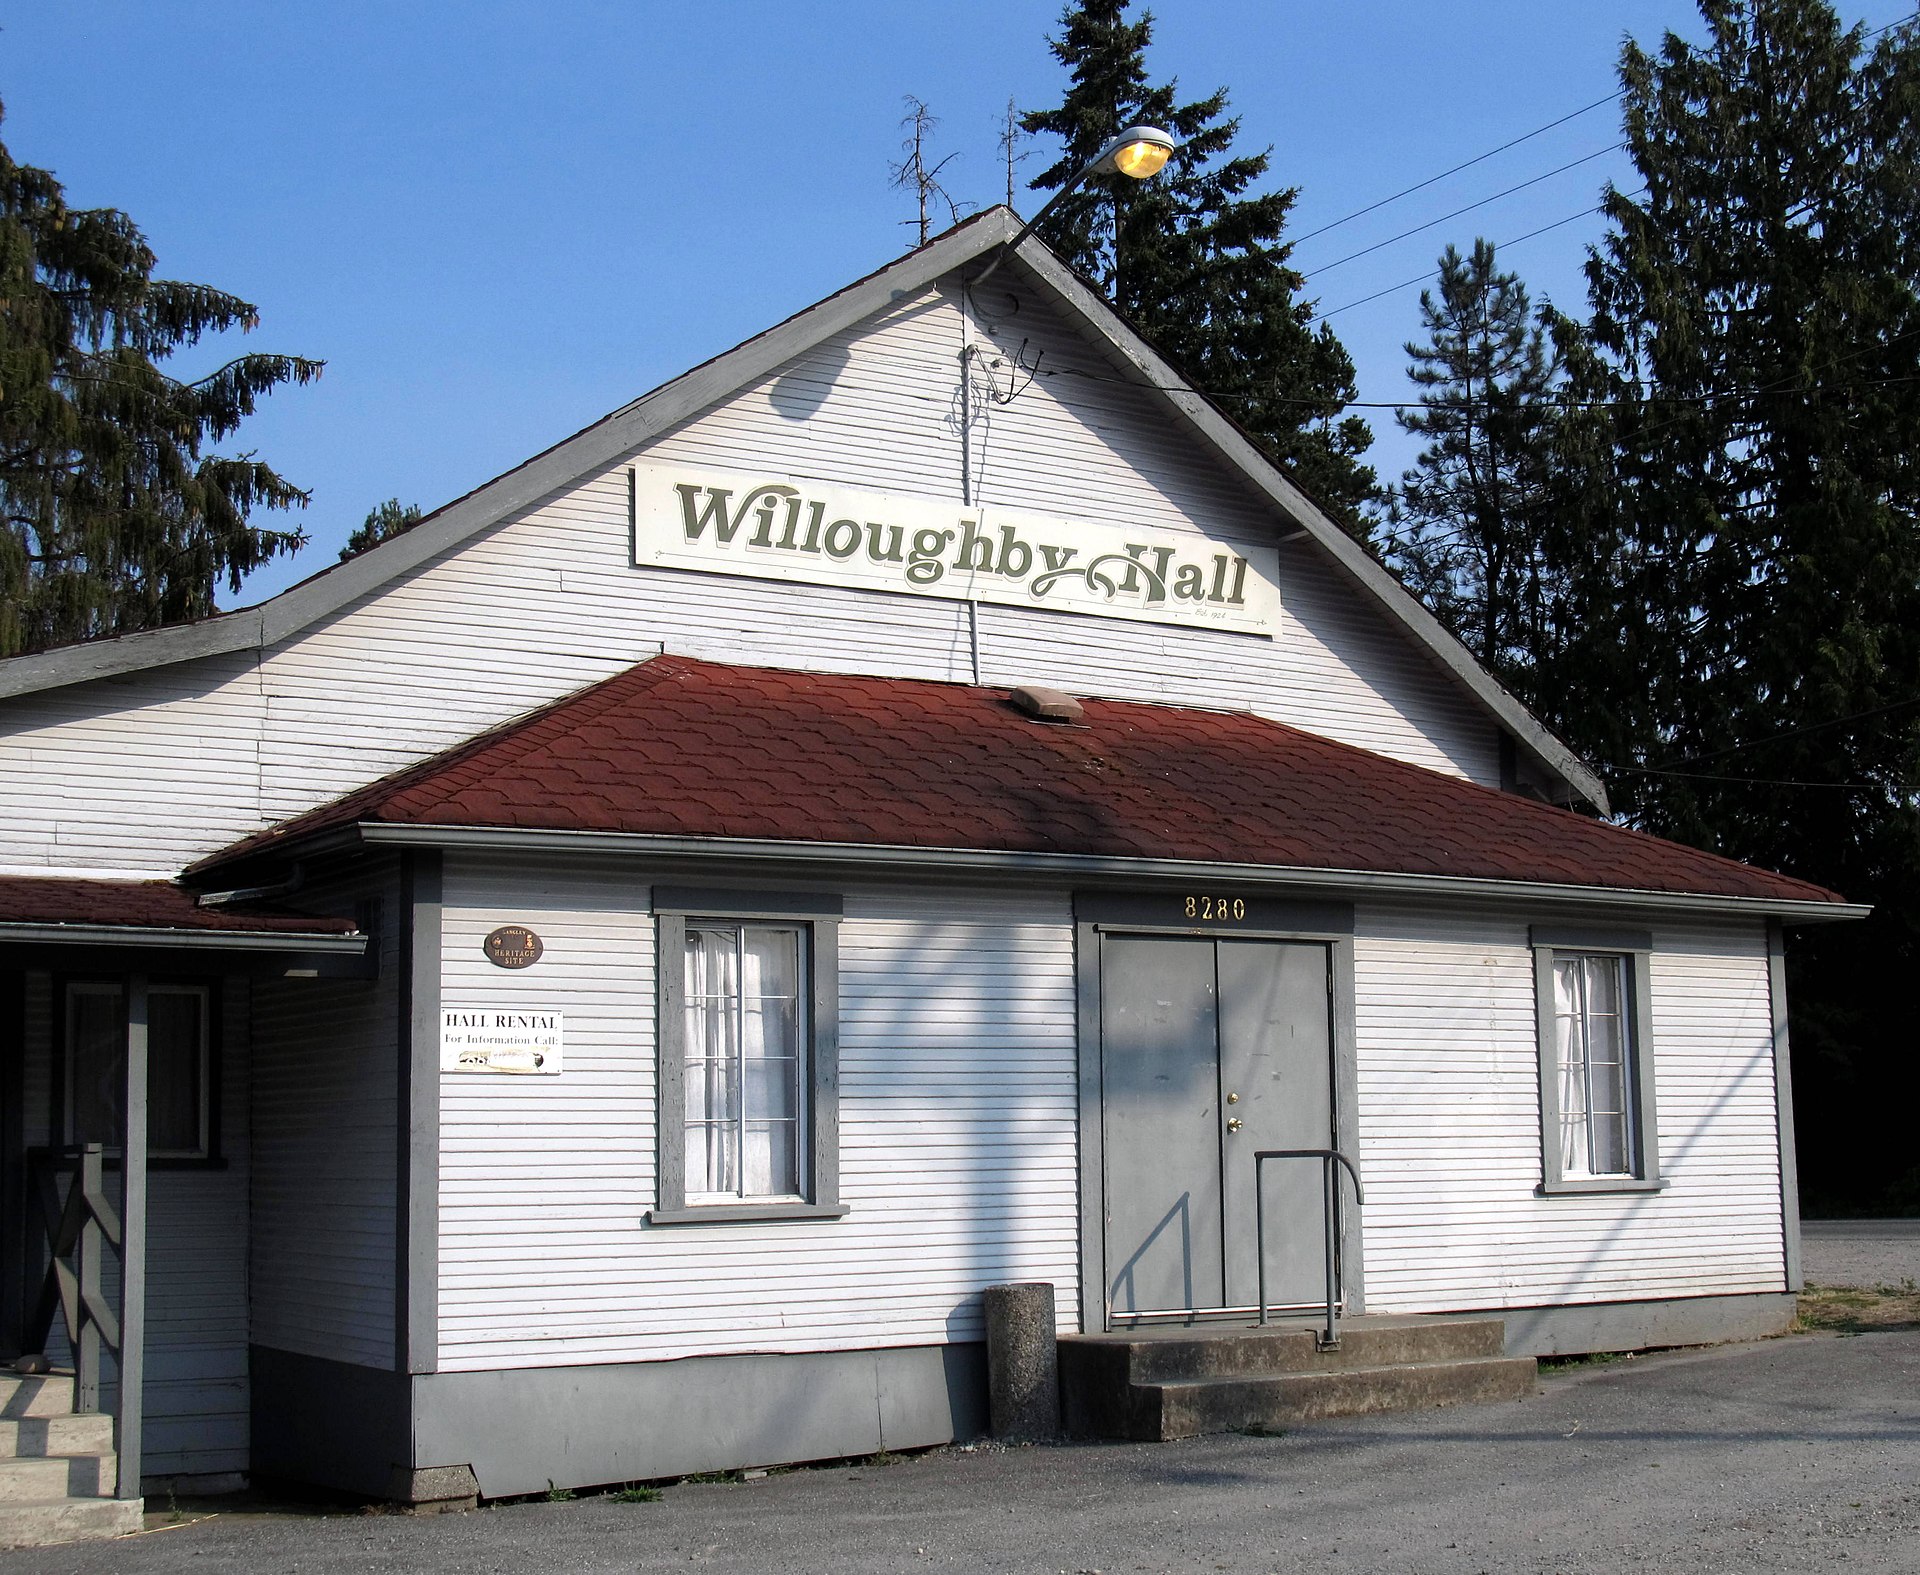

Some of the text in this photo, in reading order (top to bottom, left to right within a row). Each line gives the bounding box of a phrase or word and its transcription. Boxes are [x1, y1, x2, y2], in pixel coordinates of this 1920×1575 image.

[673, 482, 1248, 606] Willoughby Hall
[1185, 896, 1245, 920] 8280
[494, 949, 535, 958] HERITAGE
[505, 957, 524, 965] SITE
[446, 1014, 558, 1030] HALL RENTAL
[445, 1034, 559, 1045] For Information Call:
